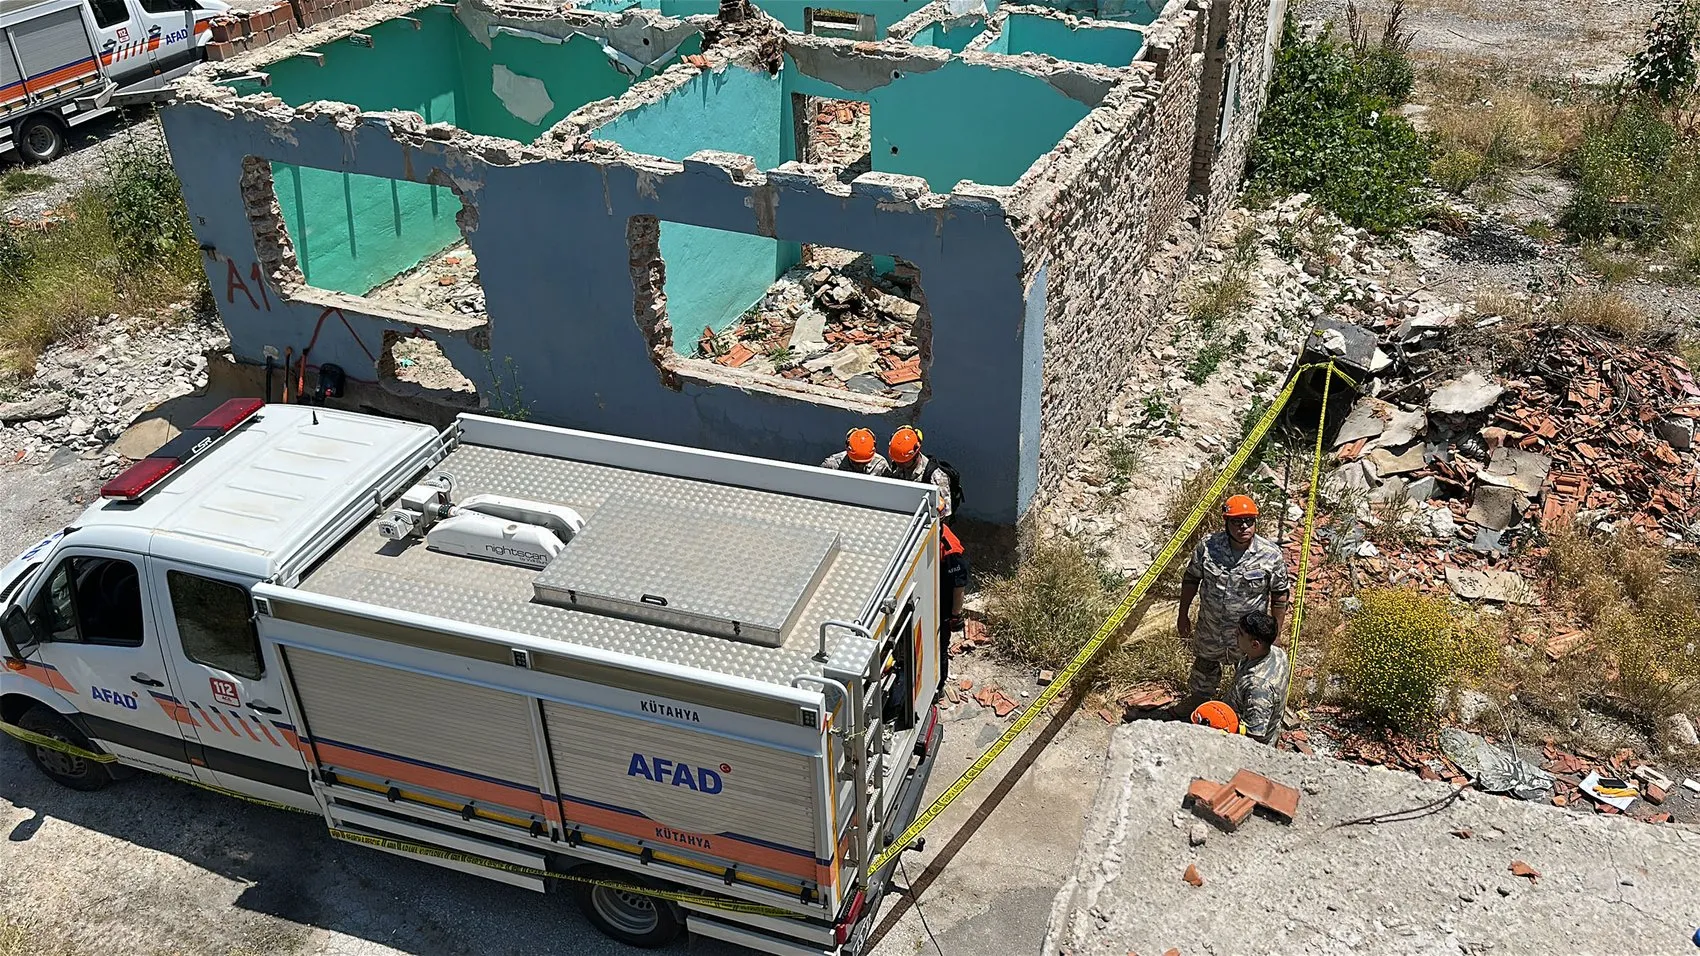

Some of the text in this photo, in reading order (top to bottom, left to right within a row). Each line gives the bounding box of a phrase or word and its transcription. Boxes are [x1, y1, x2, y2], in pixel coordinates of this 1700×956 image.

[165, 28, 188, 45] AFAD
[228, 258, 271, 311] A1
[191, 436, 212, 453] CSR
[486, 544, 548, 562] nightscan
[91, 685, 137, 710] AFAD
[213, 681, 235, 697] 112
[641, 700, 700, 723] KÜTAHYA
[627, 753, 723, 795] AFAD
[656, 827, 712, 850] KÜTAHYA
